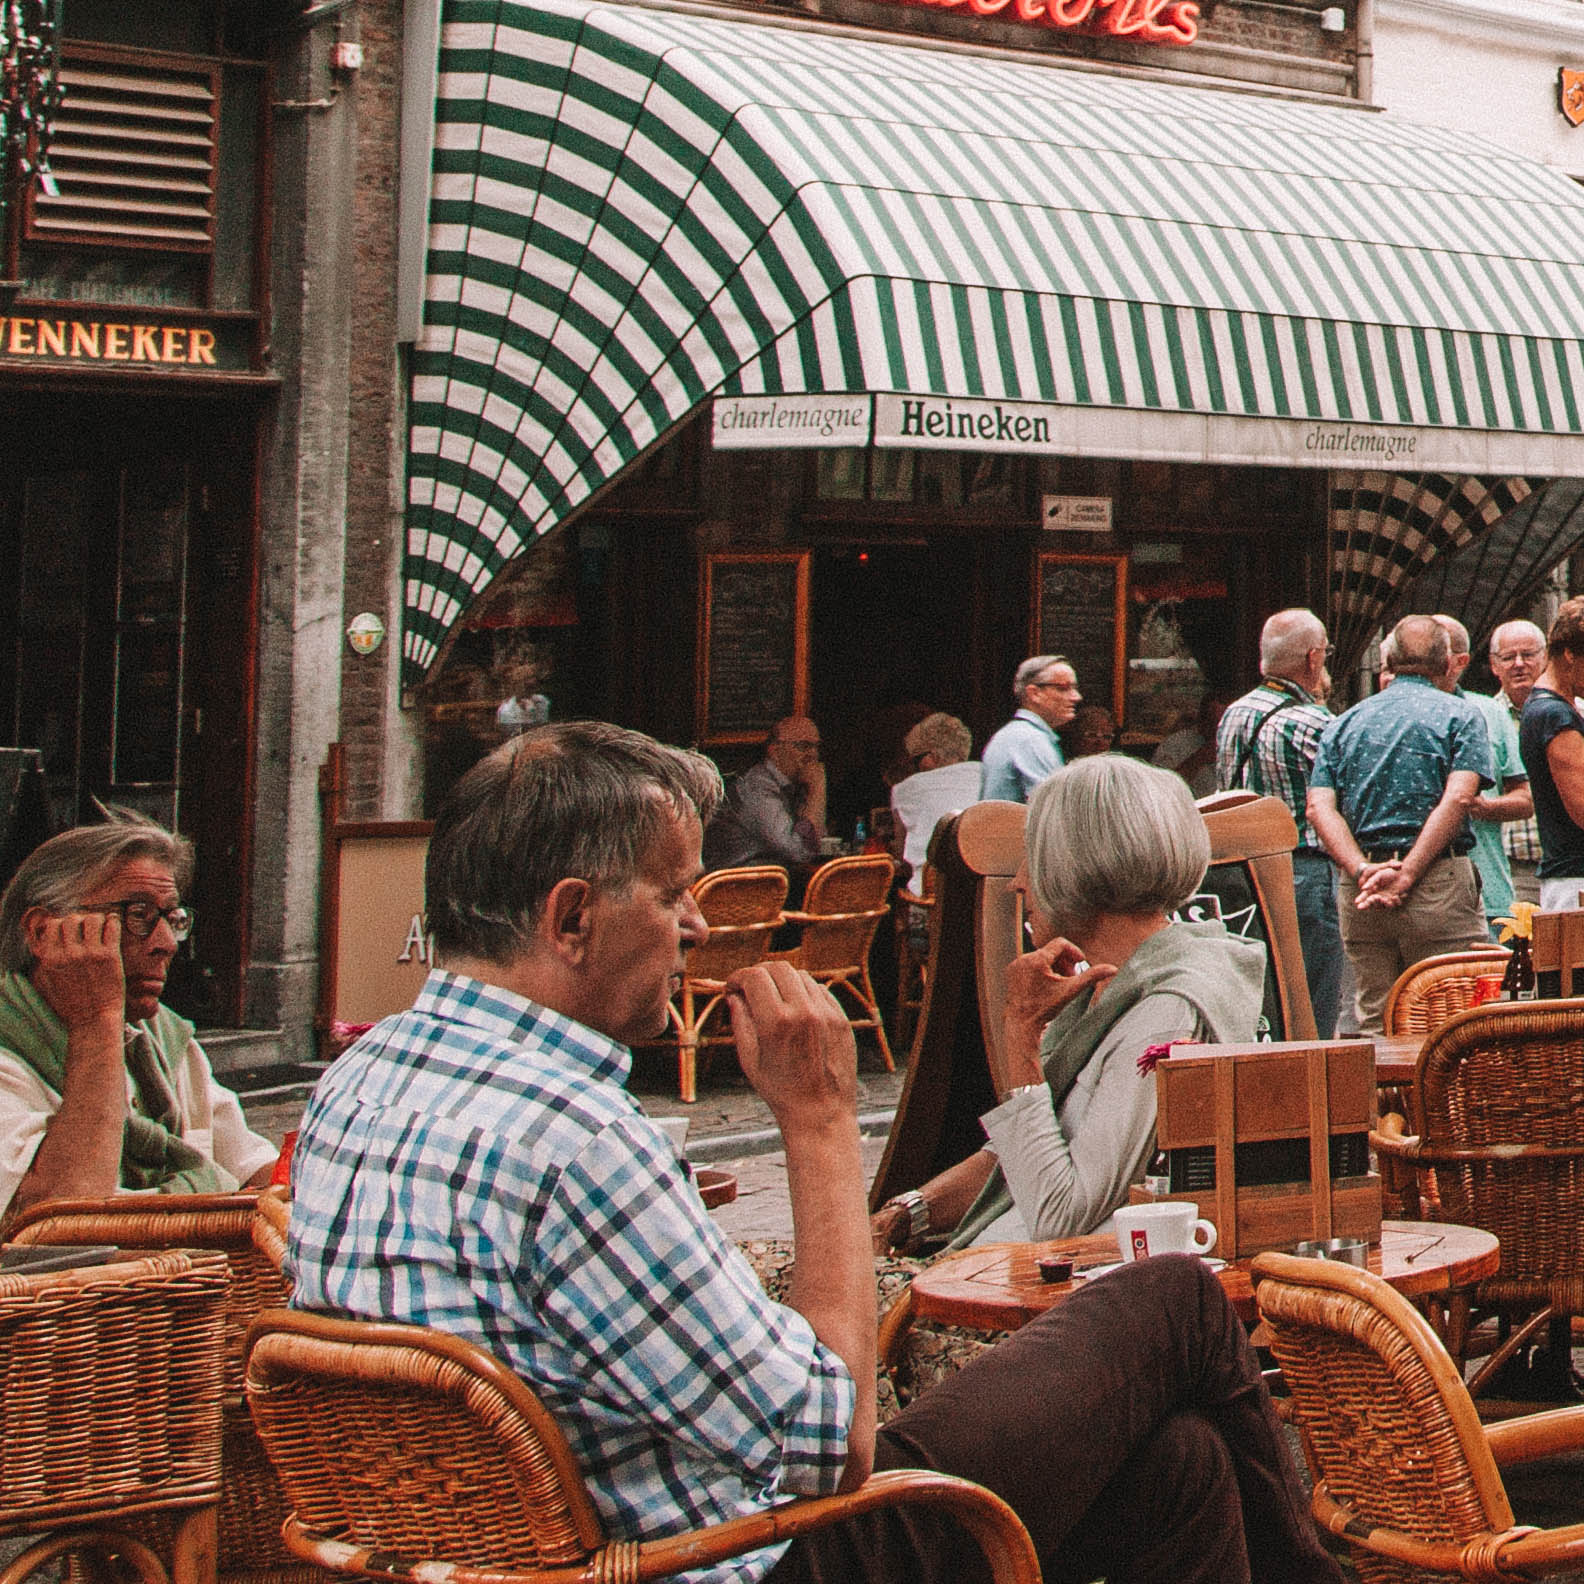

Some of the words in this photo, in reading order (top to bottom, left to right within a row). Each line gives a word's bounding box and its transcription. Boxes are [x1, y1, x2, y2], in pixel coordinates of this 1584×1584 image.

[0, 317, 217, 365] ENNEKER
[720, 402, 863, 437] charlemagne
[900, 400, 1051, 443] Heineken
[1304, 426, 1417, 461] charlemagne
